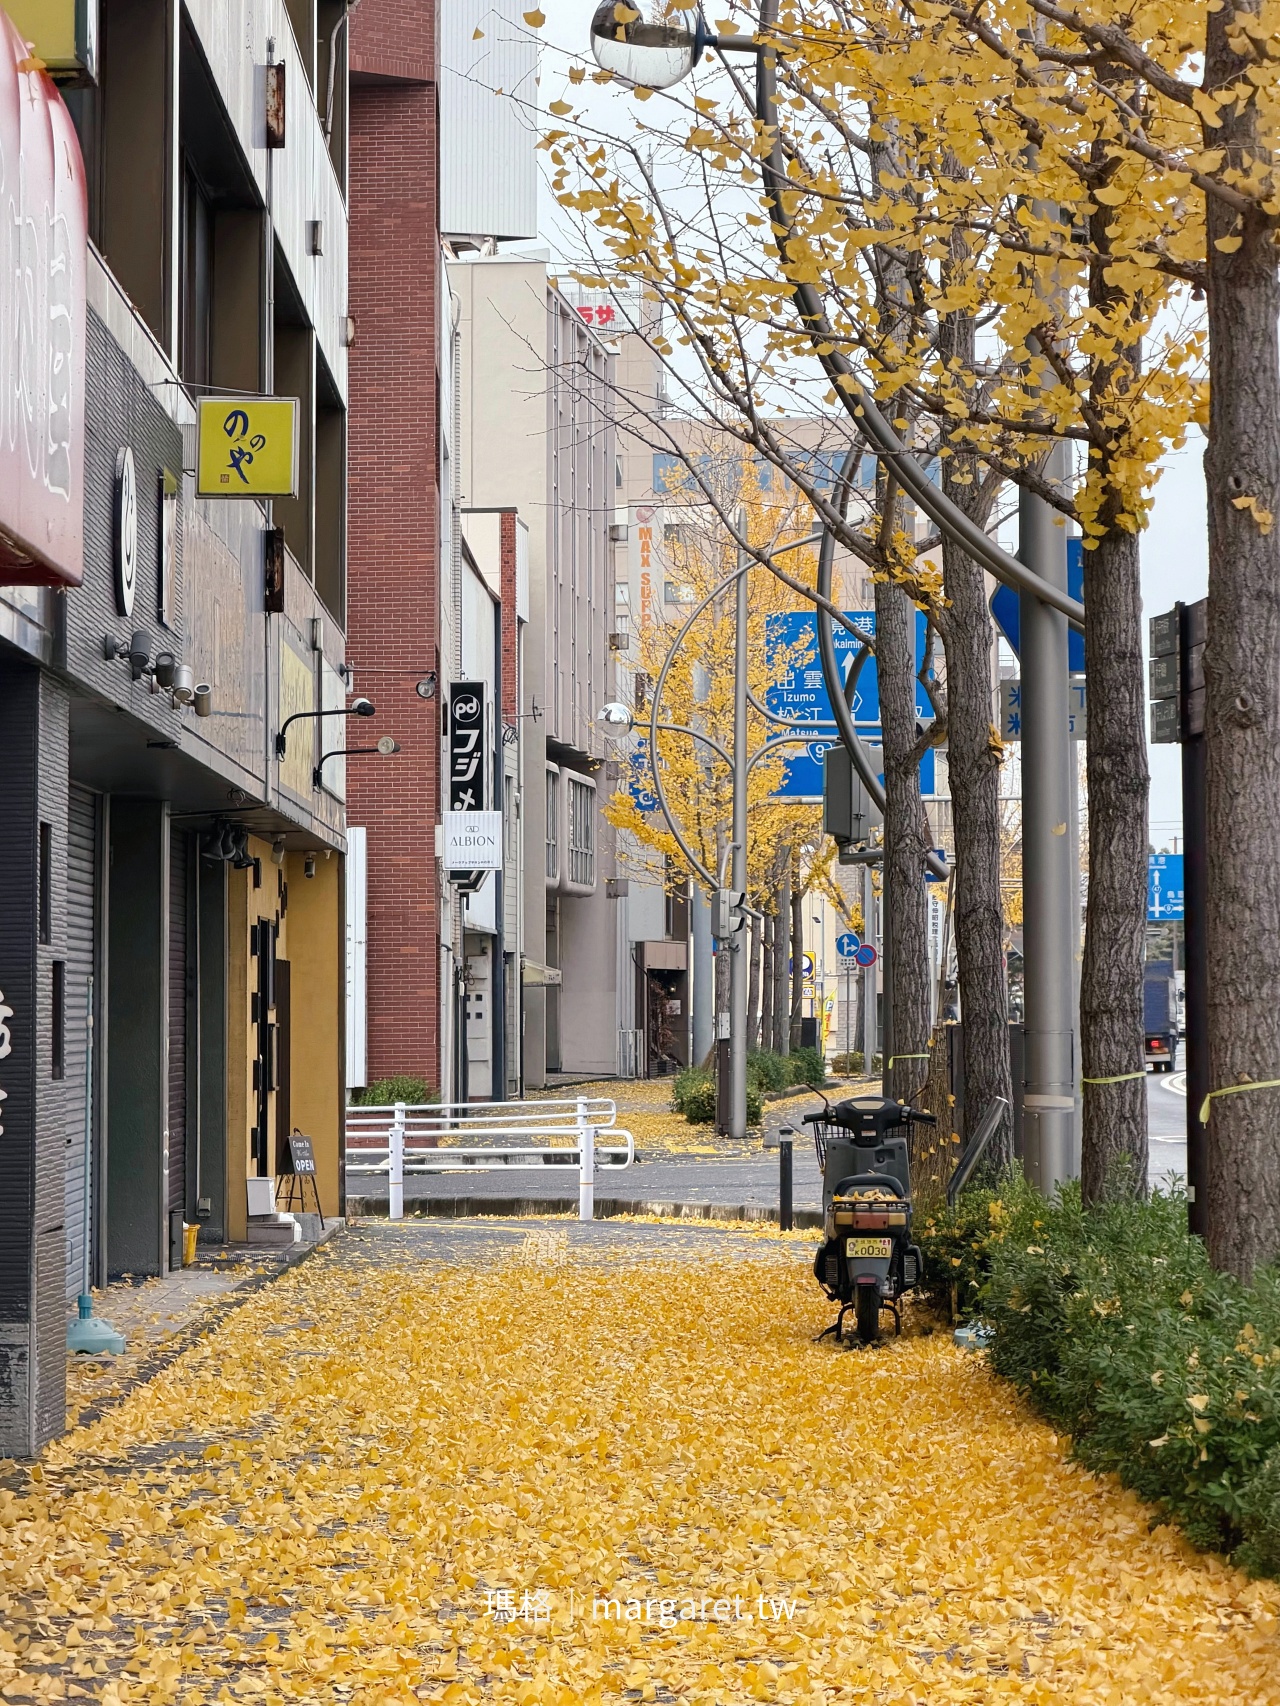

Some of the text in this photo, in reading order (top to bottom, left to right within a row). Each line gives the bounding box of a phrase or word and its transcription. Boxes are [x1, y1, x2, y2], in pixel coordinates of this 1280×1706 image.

[638, 527, 653, 567] MAX
[783, 692, 816, 702] Izumo
[815, 745, 825, 758] 9
[450, 836, 495, 846] ALBION
[295, 1159, 315, 1171] OPEN
